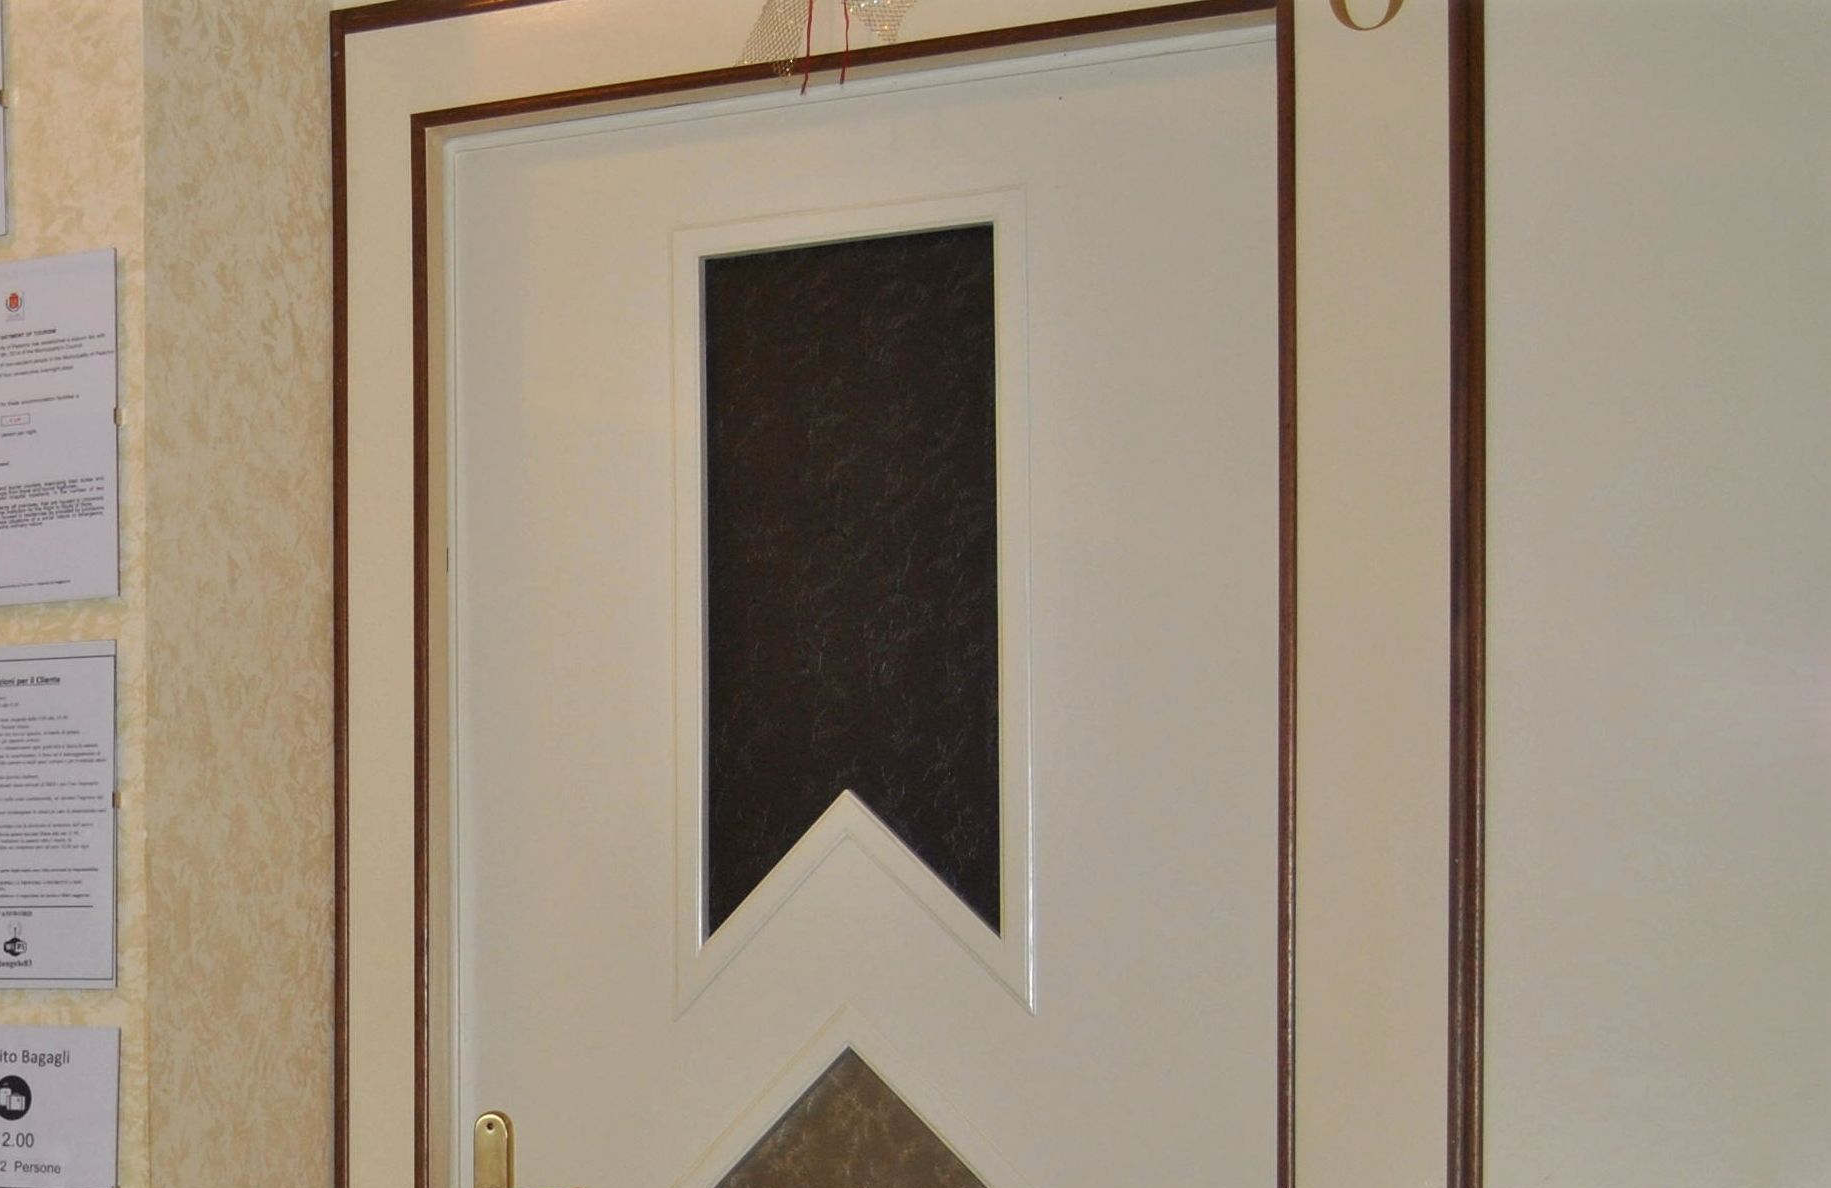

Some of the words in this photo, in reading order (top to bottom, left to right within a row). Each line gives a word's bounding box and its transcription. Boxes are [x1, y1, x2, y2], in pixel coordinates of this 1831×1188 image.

[36, 676, 60, 684] Cliente
[21, 1049, 70, 1067] Bagagli
[1, 1131, 35, 1148] 2.00
[0, 1160, 7, 1172] 2
[14, 1160, 61, 1174] Persone
